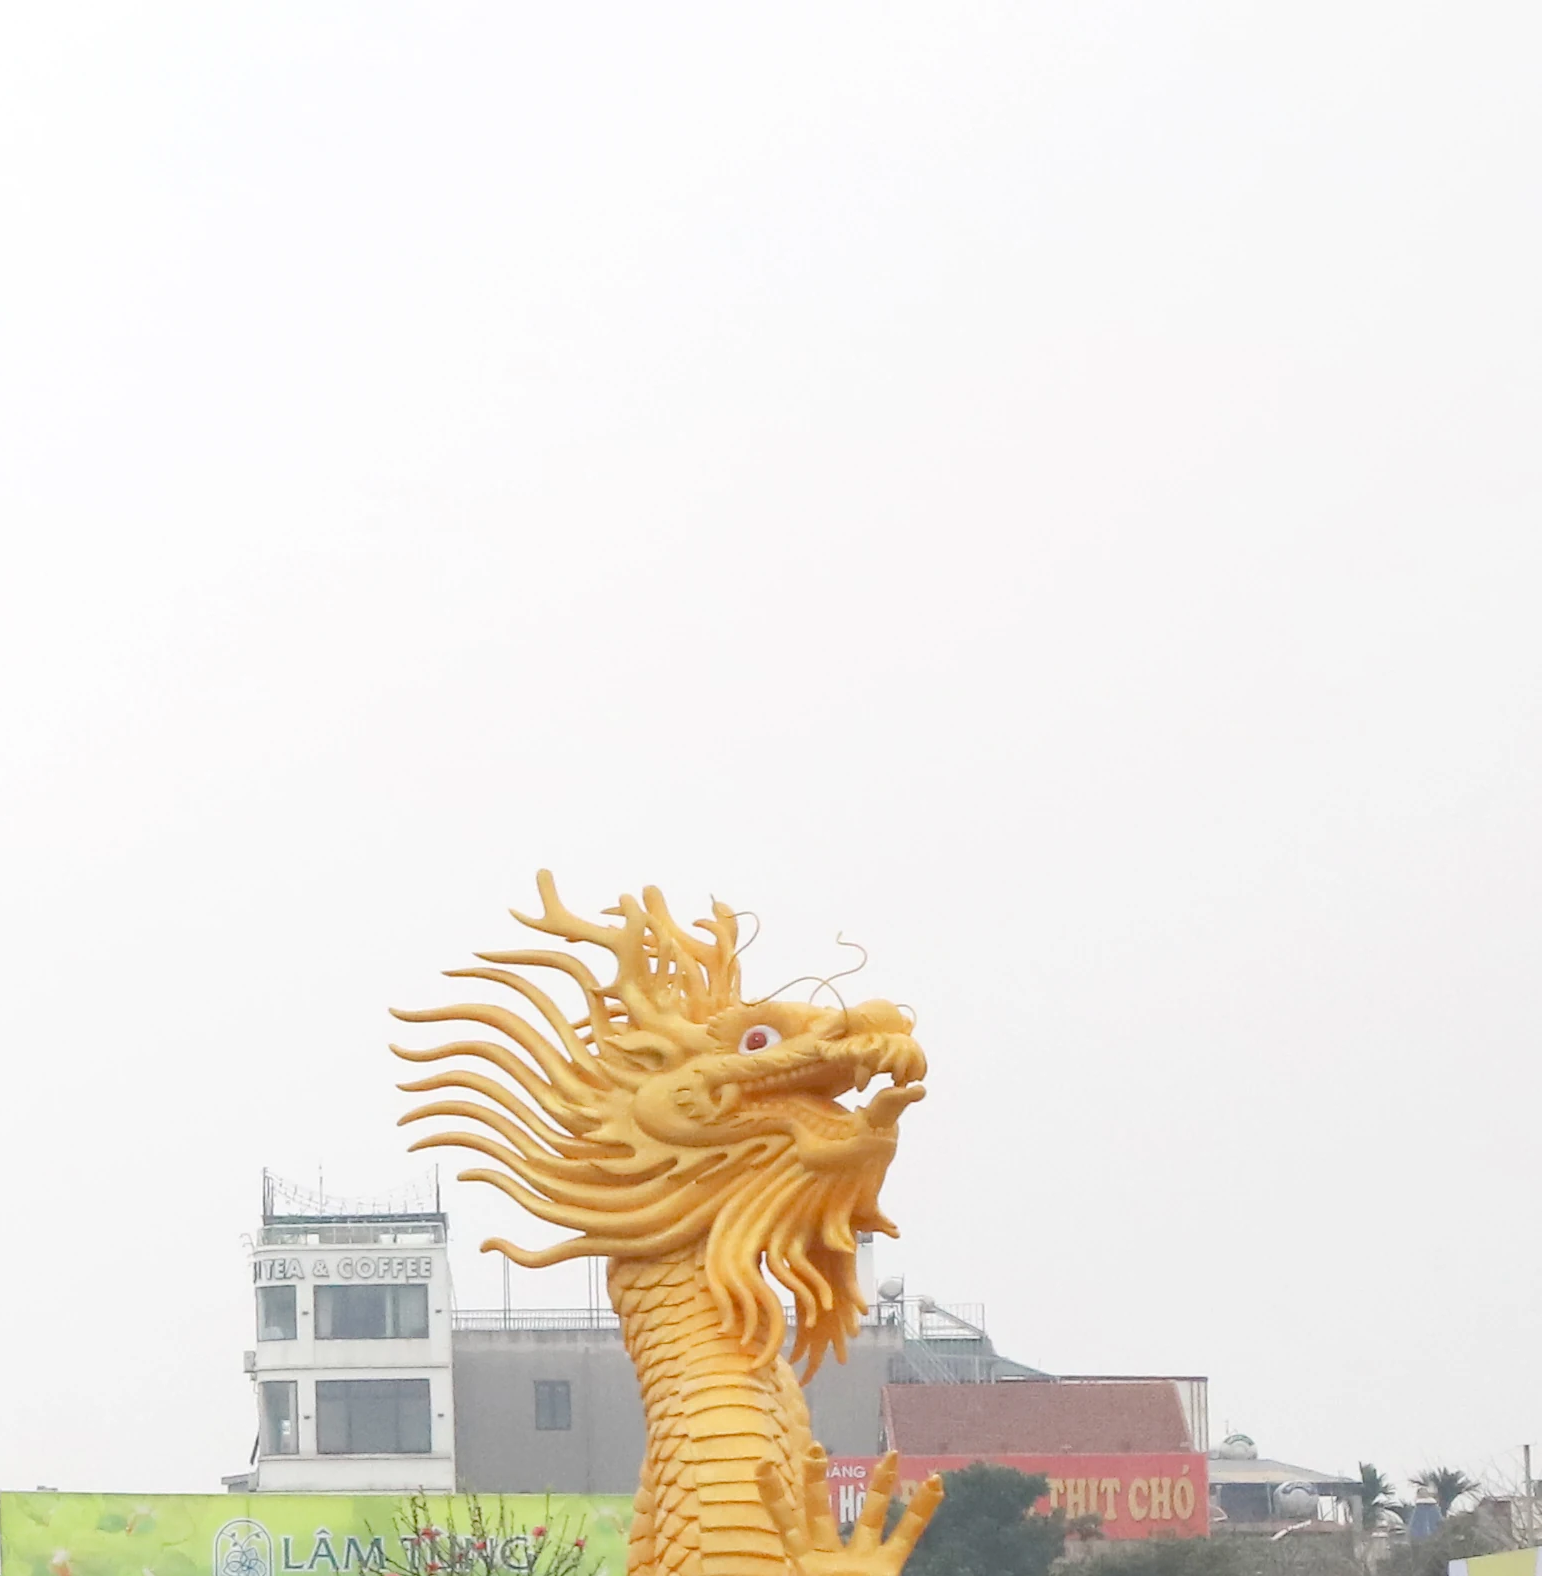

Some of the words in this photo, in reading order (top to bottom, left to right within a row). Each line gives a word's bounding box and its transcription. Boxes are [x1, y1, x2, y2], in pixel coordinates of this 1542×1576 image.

[262, 1258, 305, 1281] TEA
[312, 1260, 330, 1278] &
[336, 1256, 432, 1280] COFFEE
[1127, 1464, 1196, 1522] CHÓ
[281, 1527, 388, 1573] LÂM
